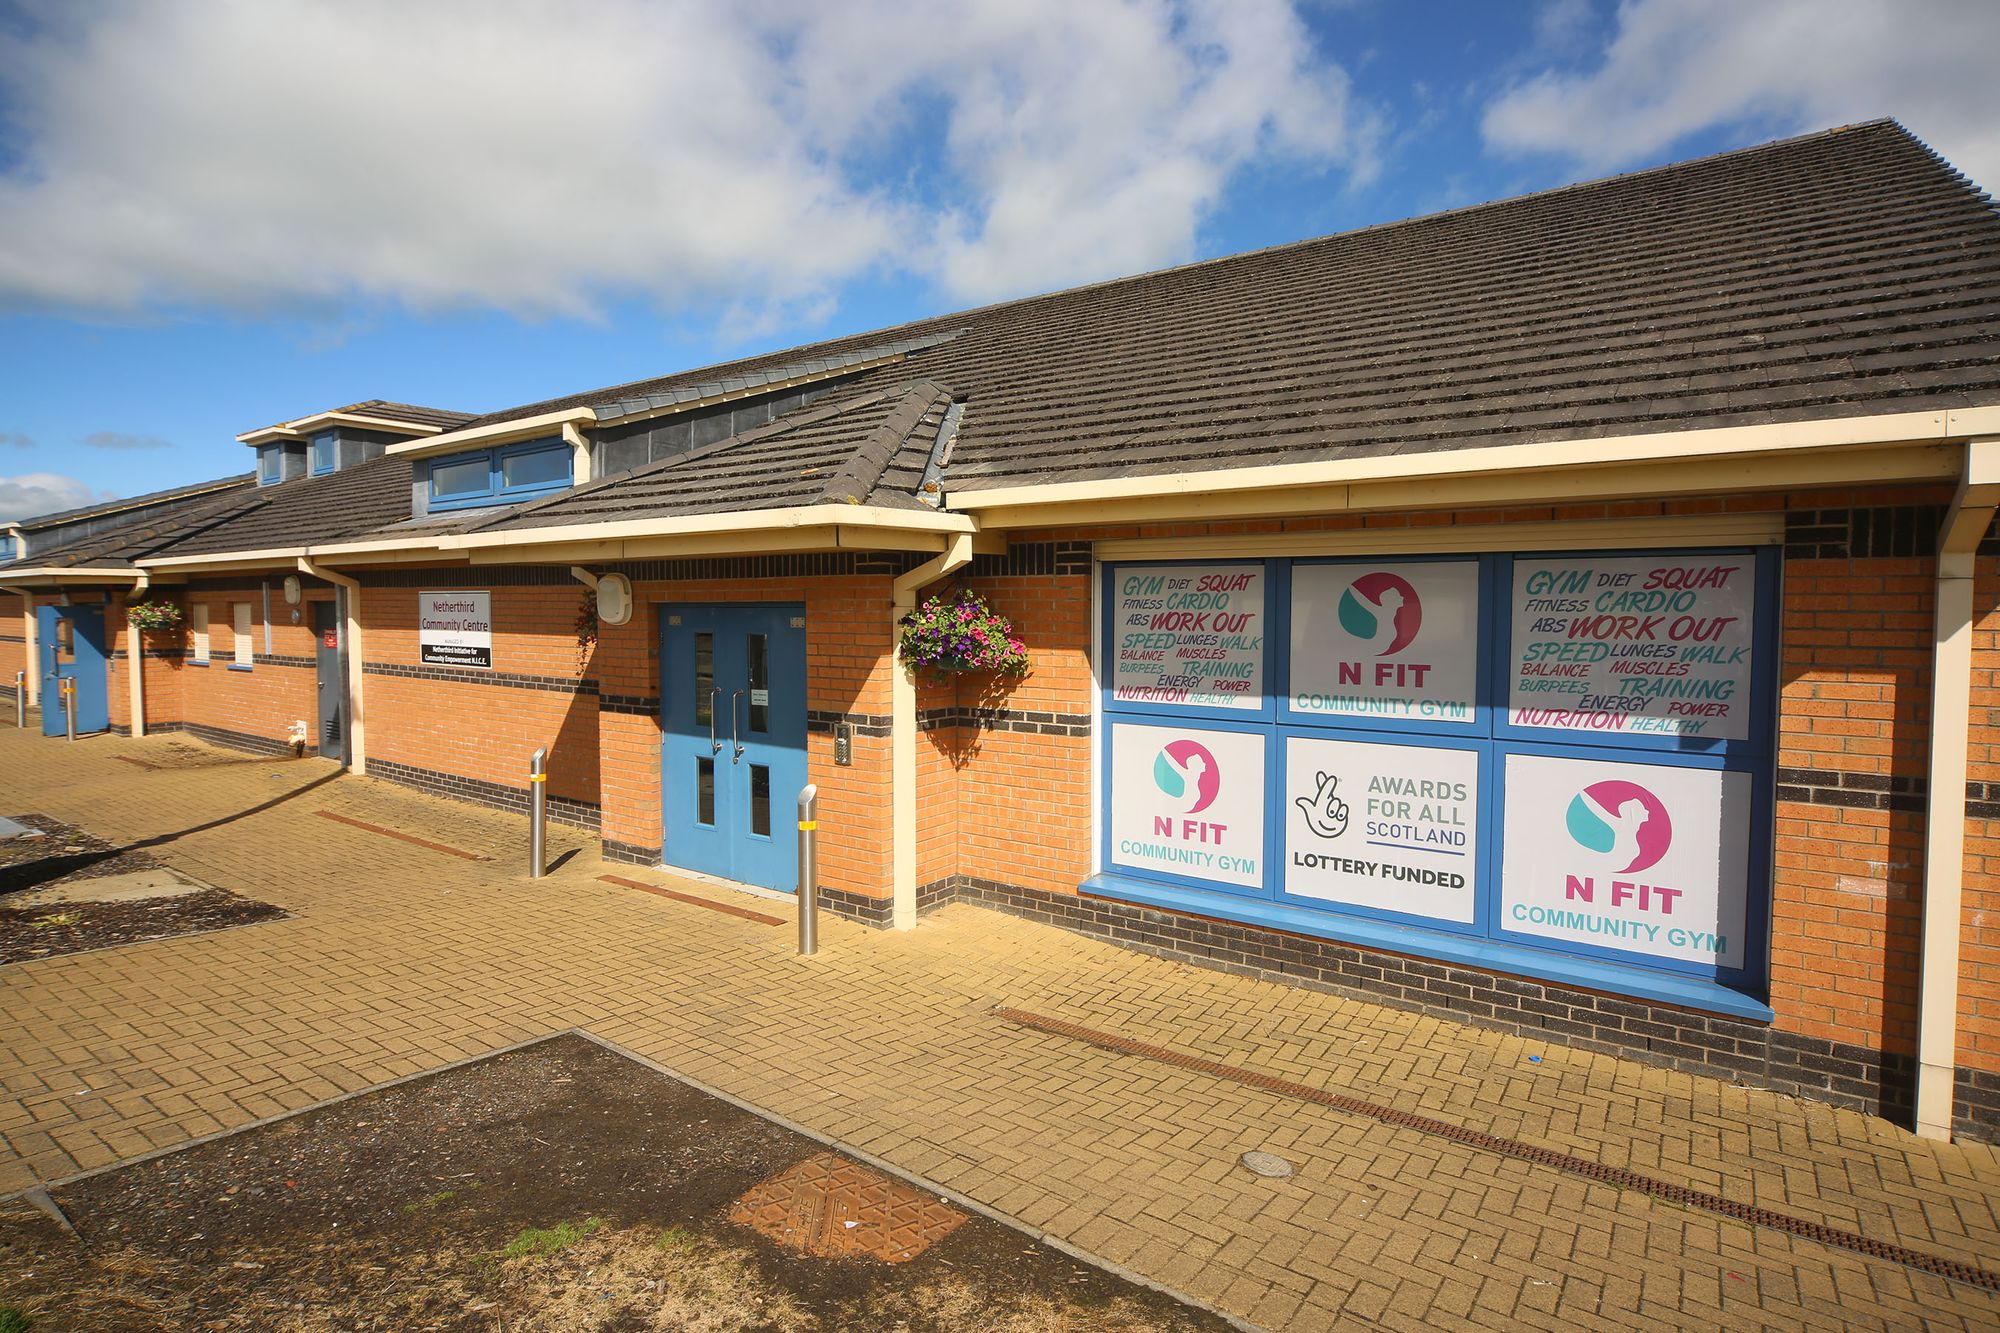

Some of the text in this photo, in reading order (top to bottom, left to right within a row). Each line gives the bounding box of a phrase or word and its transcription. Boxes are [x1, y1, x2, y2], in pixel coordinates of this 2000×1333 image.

[1123, 573, 1256, 595] GYM DIET SQUAT
[1525, 567, 1740, 595] GYM DIET SQUAT
[433, 601, 474, 612] Netherthird
[1122, 592, 1229, 610] FITNESS CARDIO
[1525, 591, 1697, 613] FITNESS CARDIO
[422, 618, 488, 632] Community Centre
[1127, 612, 1255, 632] ABS WORK OUT
[1530, 615, 1739, 642] ABS WORK OUT
[1122, 633, 1263, 650] SPEED LUNGES WALK
[1120, 648, 1226, 661] BALANCE MUSCLES
[1523, 642, 1751, 664] SPEED LUNGES WALK
[1119, 661, 1253, 678] BURPEES TRAINING
[1339, 662, 1431, 688] N FIT
[1520, 661, 1691, 677] BALANCE MUSCLES
[1118, 685, 1237, 704] NUTRITION HEALTHY
[1157, 675, 1251, 692] ENERGY POWER
[1519, 677, 1735, 700] BURPEES TRAINING
[1297, 693, 1466, 717] COMMUNITY GYM
[1578, 695, 1730, 717] ENERGY POWER
[1515, 707, 1708, 734] NUTRITION HEALTHY
[1368, 776, 1467, 801] AWARDS
[1367, 798, 1466, 826] FOR ALL
[1154, 816, 1227, 845] N FIT
[1367, 821, 1466, 846] SCOTLAND
[1121, 840, 1255, 874] COMMUNITY GYM
[1294, 852, 1465, 888] LOTTERY FUNDED
[1566, 874, 1683, 914] N FIT
[1512, 904, 1727, 953] COMMUNITY GYM
